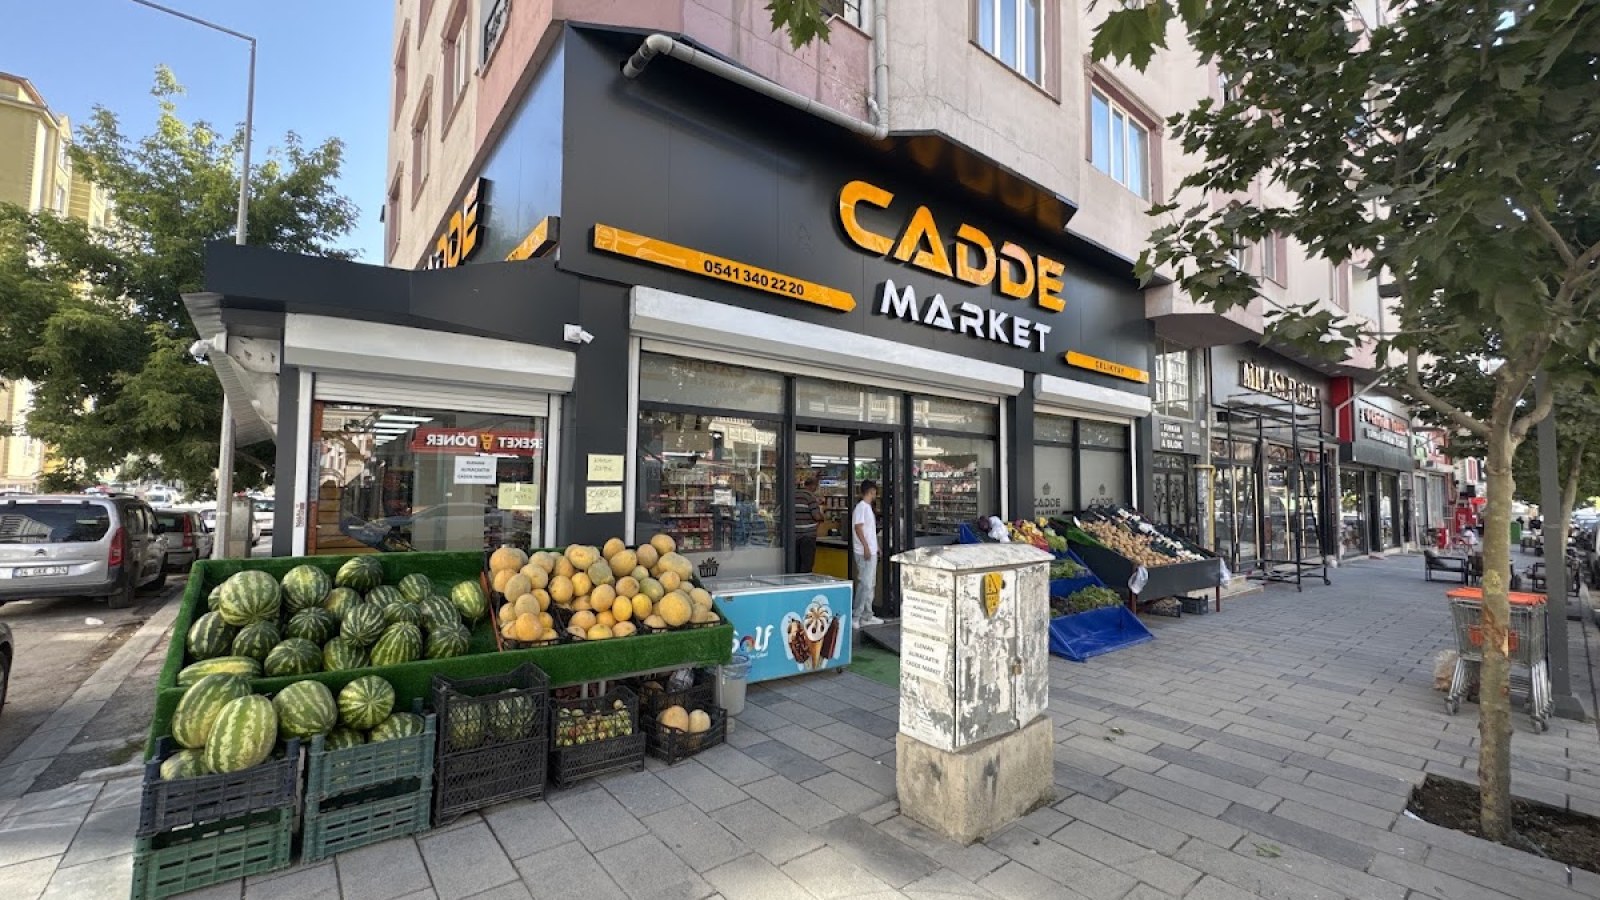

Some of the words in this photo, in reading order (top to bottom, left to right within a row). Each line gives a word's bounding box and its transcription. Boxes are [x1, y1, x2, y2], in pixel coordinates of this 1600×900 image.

[704, 260, 738, 280] 0541
[743, 270, 768, 286] 340
[839, 180, 1066, 312] CADDE
[880, 279, 1052, 353] MARKET
